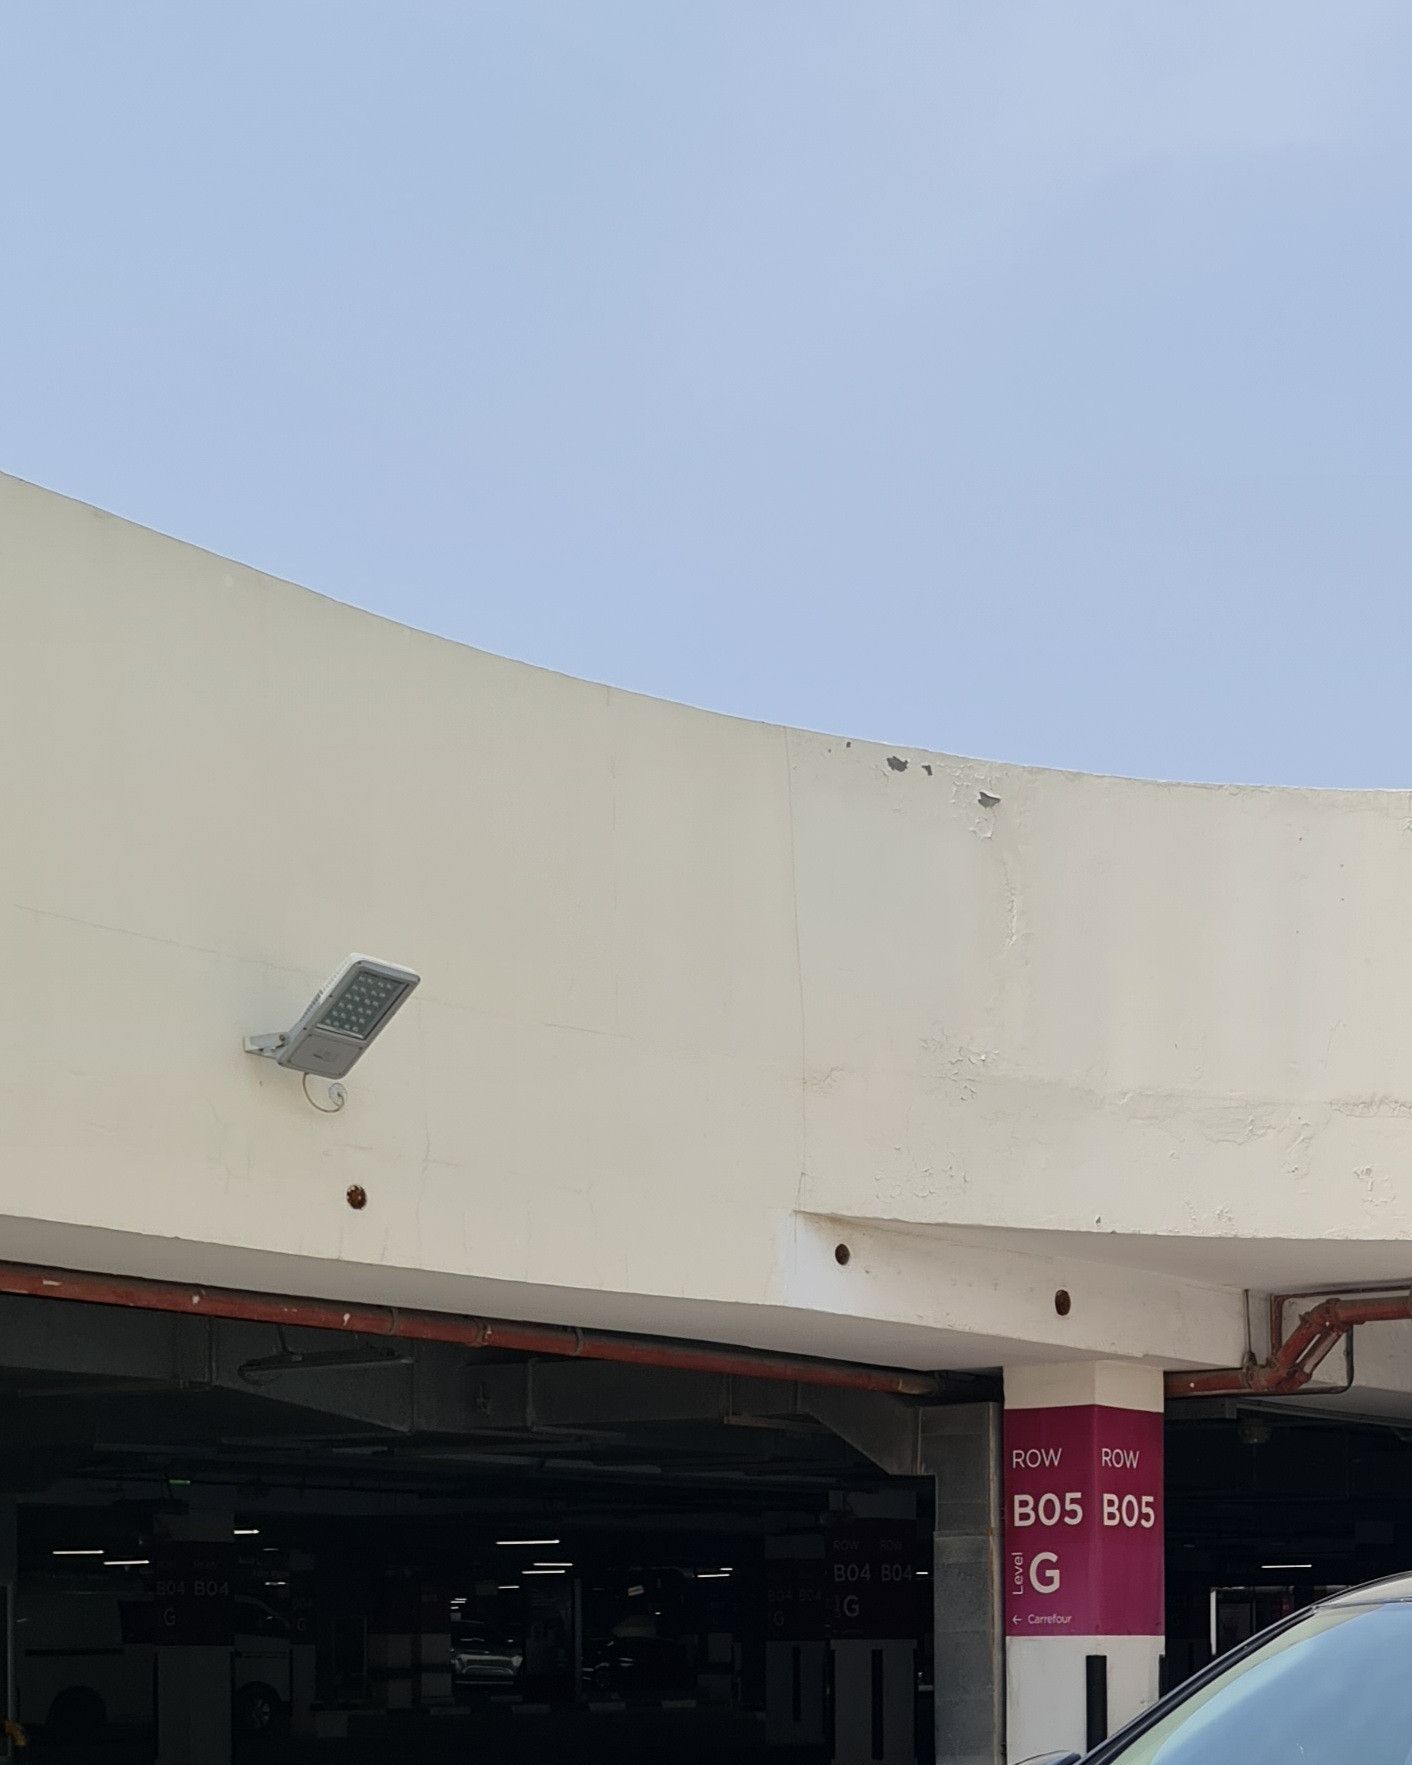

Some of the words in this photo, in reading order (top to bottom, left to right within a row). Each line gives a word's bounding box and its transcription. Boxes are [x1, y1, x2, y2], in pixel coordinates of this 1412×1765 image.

[1012, 1448, 1062, 1469] ROW
[1102, 1448, 1139, 1469] ROW
[1013, 1492, 1083, 1527] B05
[1103, 1493, 1155, 1528] B05
[834, 1563, 871, 1581] B04
[881, 1564, 912, 1581] B04
[1012, 1552, 1023, 1595] Level
[1029, 1551, 1061, 1594] G
[194, 1580, 229, 1596] B04
[843, 1595, 860, 1616] G
[163, 1608, 176, 1626] G
[1027, 1613, 1072, 1625] Carrefour
